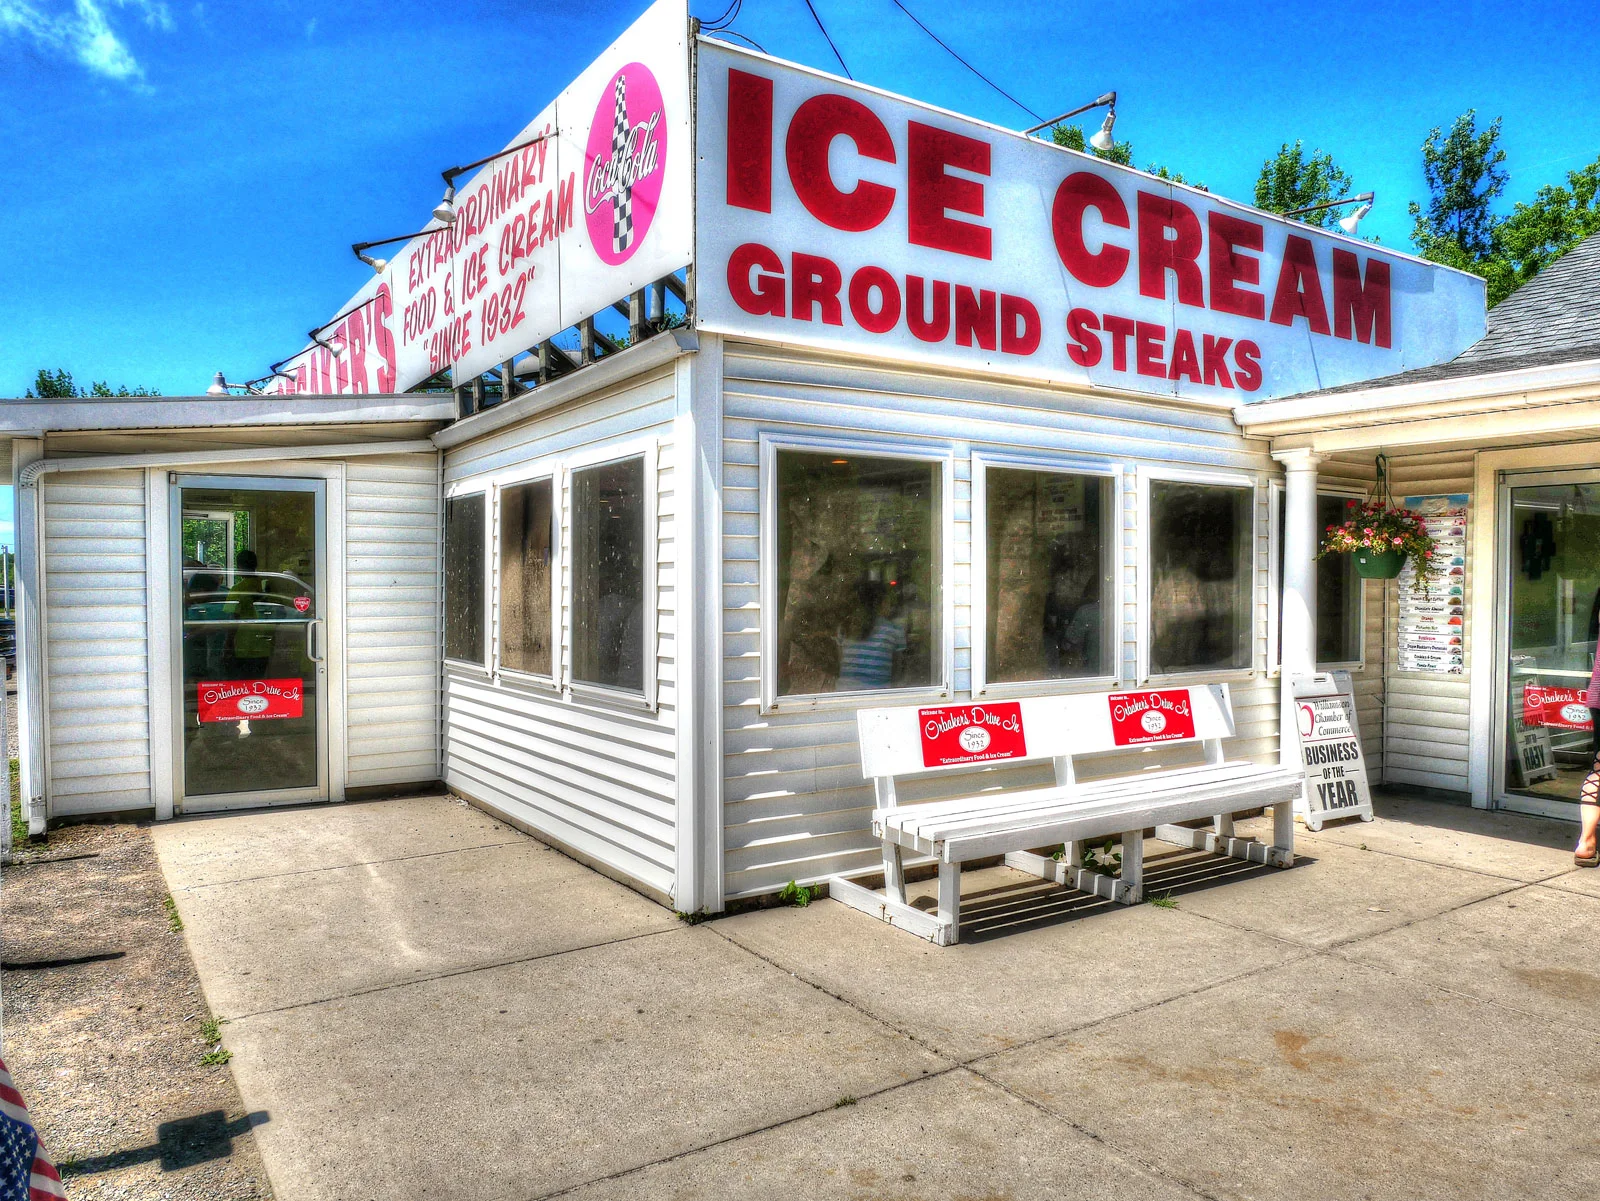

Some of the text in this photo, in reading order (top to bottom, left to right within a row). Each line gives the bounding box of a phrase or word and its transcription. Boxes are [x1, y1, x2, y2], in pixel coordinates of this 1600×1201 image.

[409, 123, 551, 294] EXTRAORDINARY
[726, 67, 1392, 349] ICE CREAM
[403, 173, 575, 347] FOOD & ICE CREAM
[726, 242, 1263, 391] GROUND STEAKS
[204, 681, 300, 705] Orbaker's Drive In
[1527, 690, 1575, 708] Orbaker's
[1114, 693, 1190, 722] Orbaker's Drive In
[1314, 709, 1353, 724] Chamber of
[1565, 705, 1588, 714] Since
[925, 707, 1020, 740] Orbaker's Drive In
[1145, 713, 1161, 724] Since
[1568, 713, 1586, 721] 1932
[964, 729, 985, 741] Since
[1148, 722, 1161, 731] 1932
[1318, 725, 1351, 736] Commerce
[967, 740, 984, 749] 1932
[1305, 742, 1359, 766] BUSINESS
[1322, 766, 1345, 780] OF THE
[1317, 779, 1359, 811] YEAR
